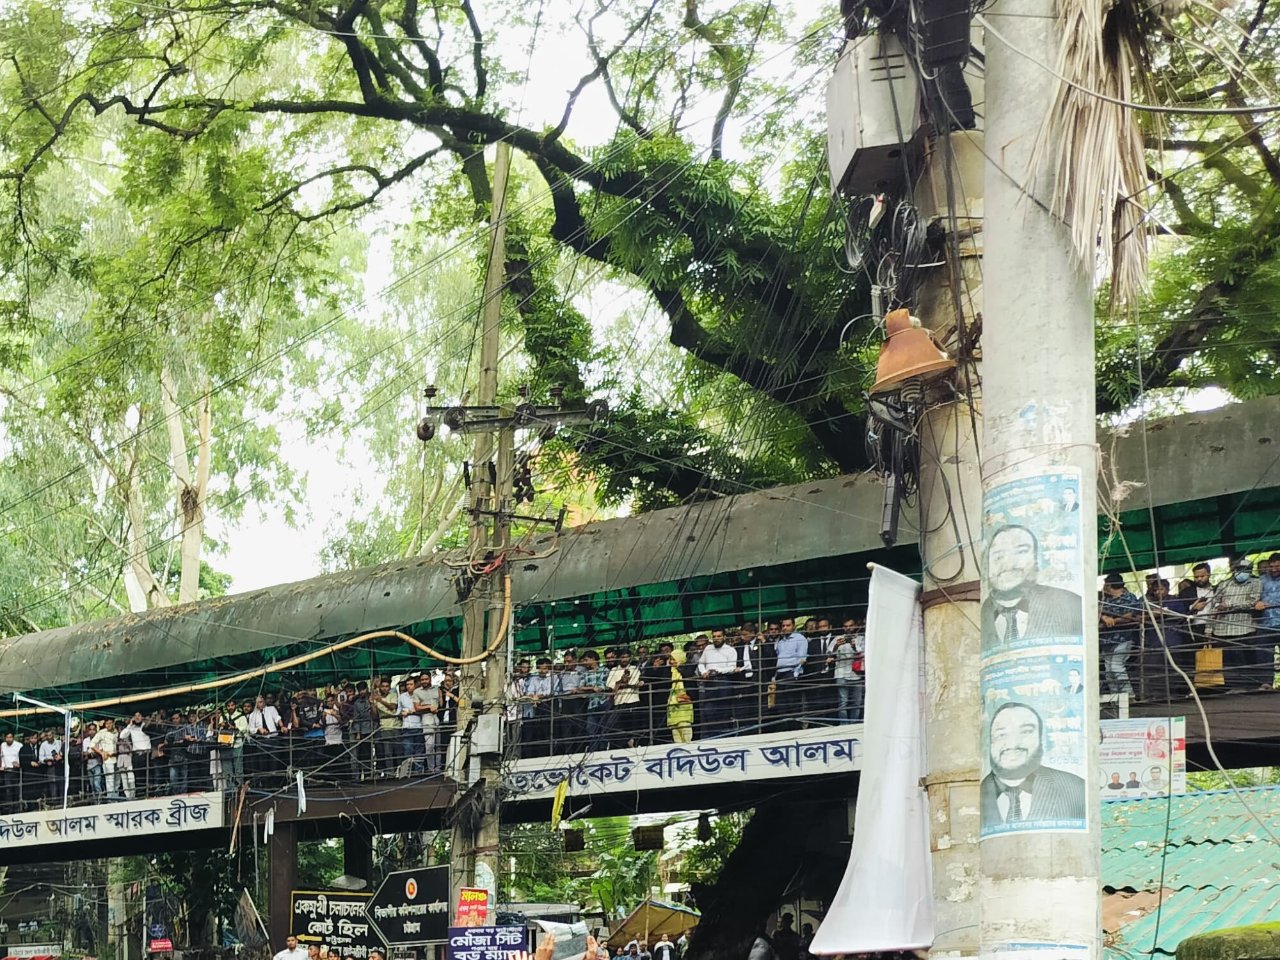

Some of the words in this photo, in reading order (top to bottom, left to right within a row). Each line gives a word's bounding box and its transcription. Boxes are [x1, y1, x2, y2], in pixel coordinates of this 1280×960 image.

[509, 755, 634, 789] ডভোকেট
[643, 746, 750, 778] বদিউল
[760, 738, 858, 768] আলম
[45, 814, 98, 836] আলম
[104, 809, 163, 829] স্মারক
[166, 799, 210, 827] ব্রীজ
[295, 895, 327, 918] একমুখী
[308, 917, 334, 934] কোর্ট
[337, 919, 368, 937] হিল
[450, 931, 492, 946] মৌজা
[495, 932, 522, 945] সিট
